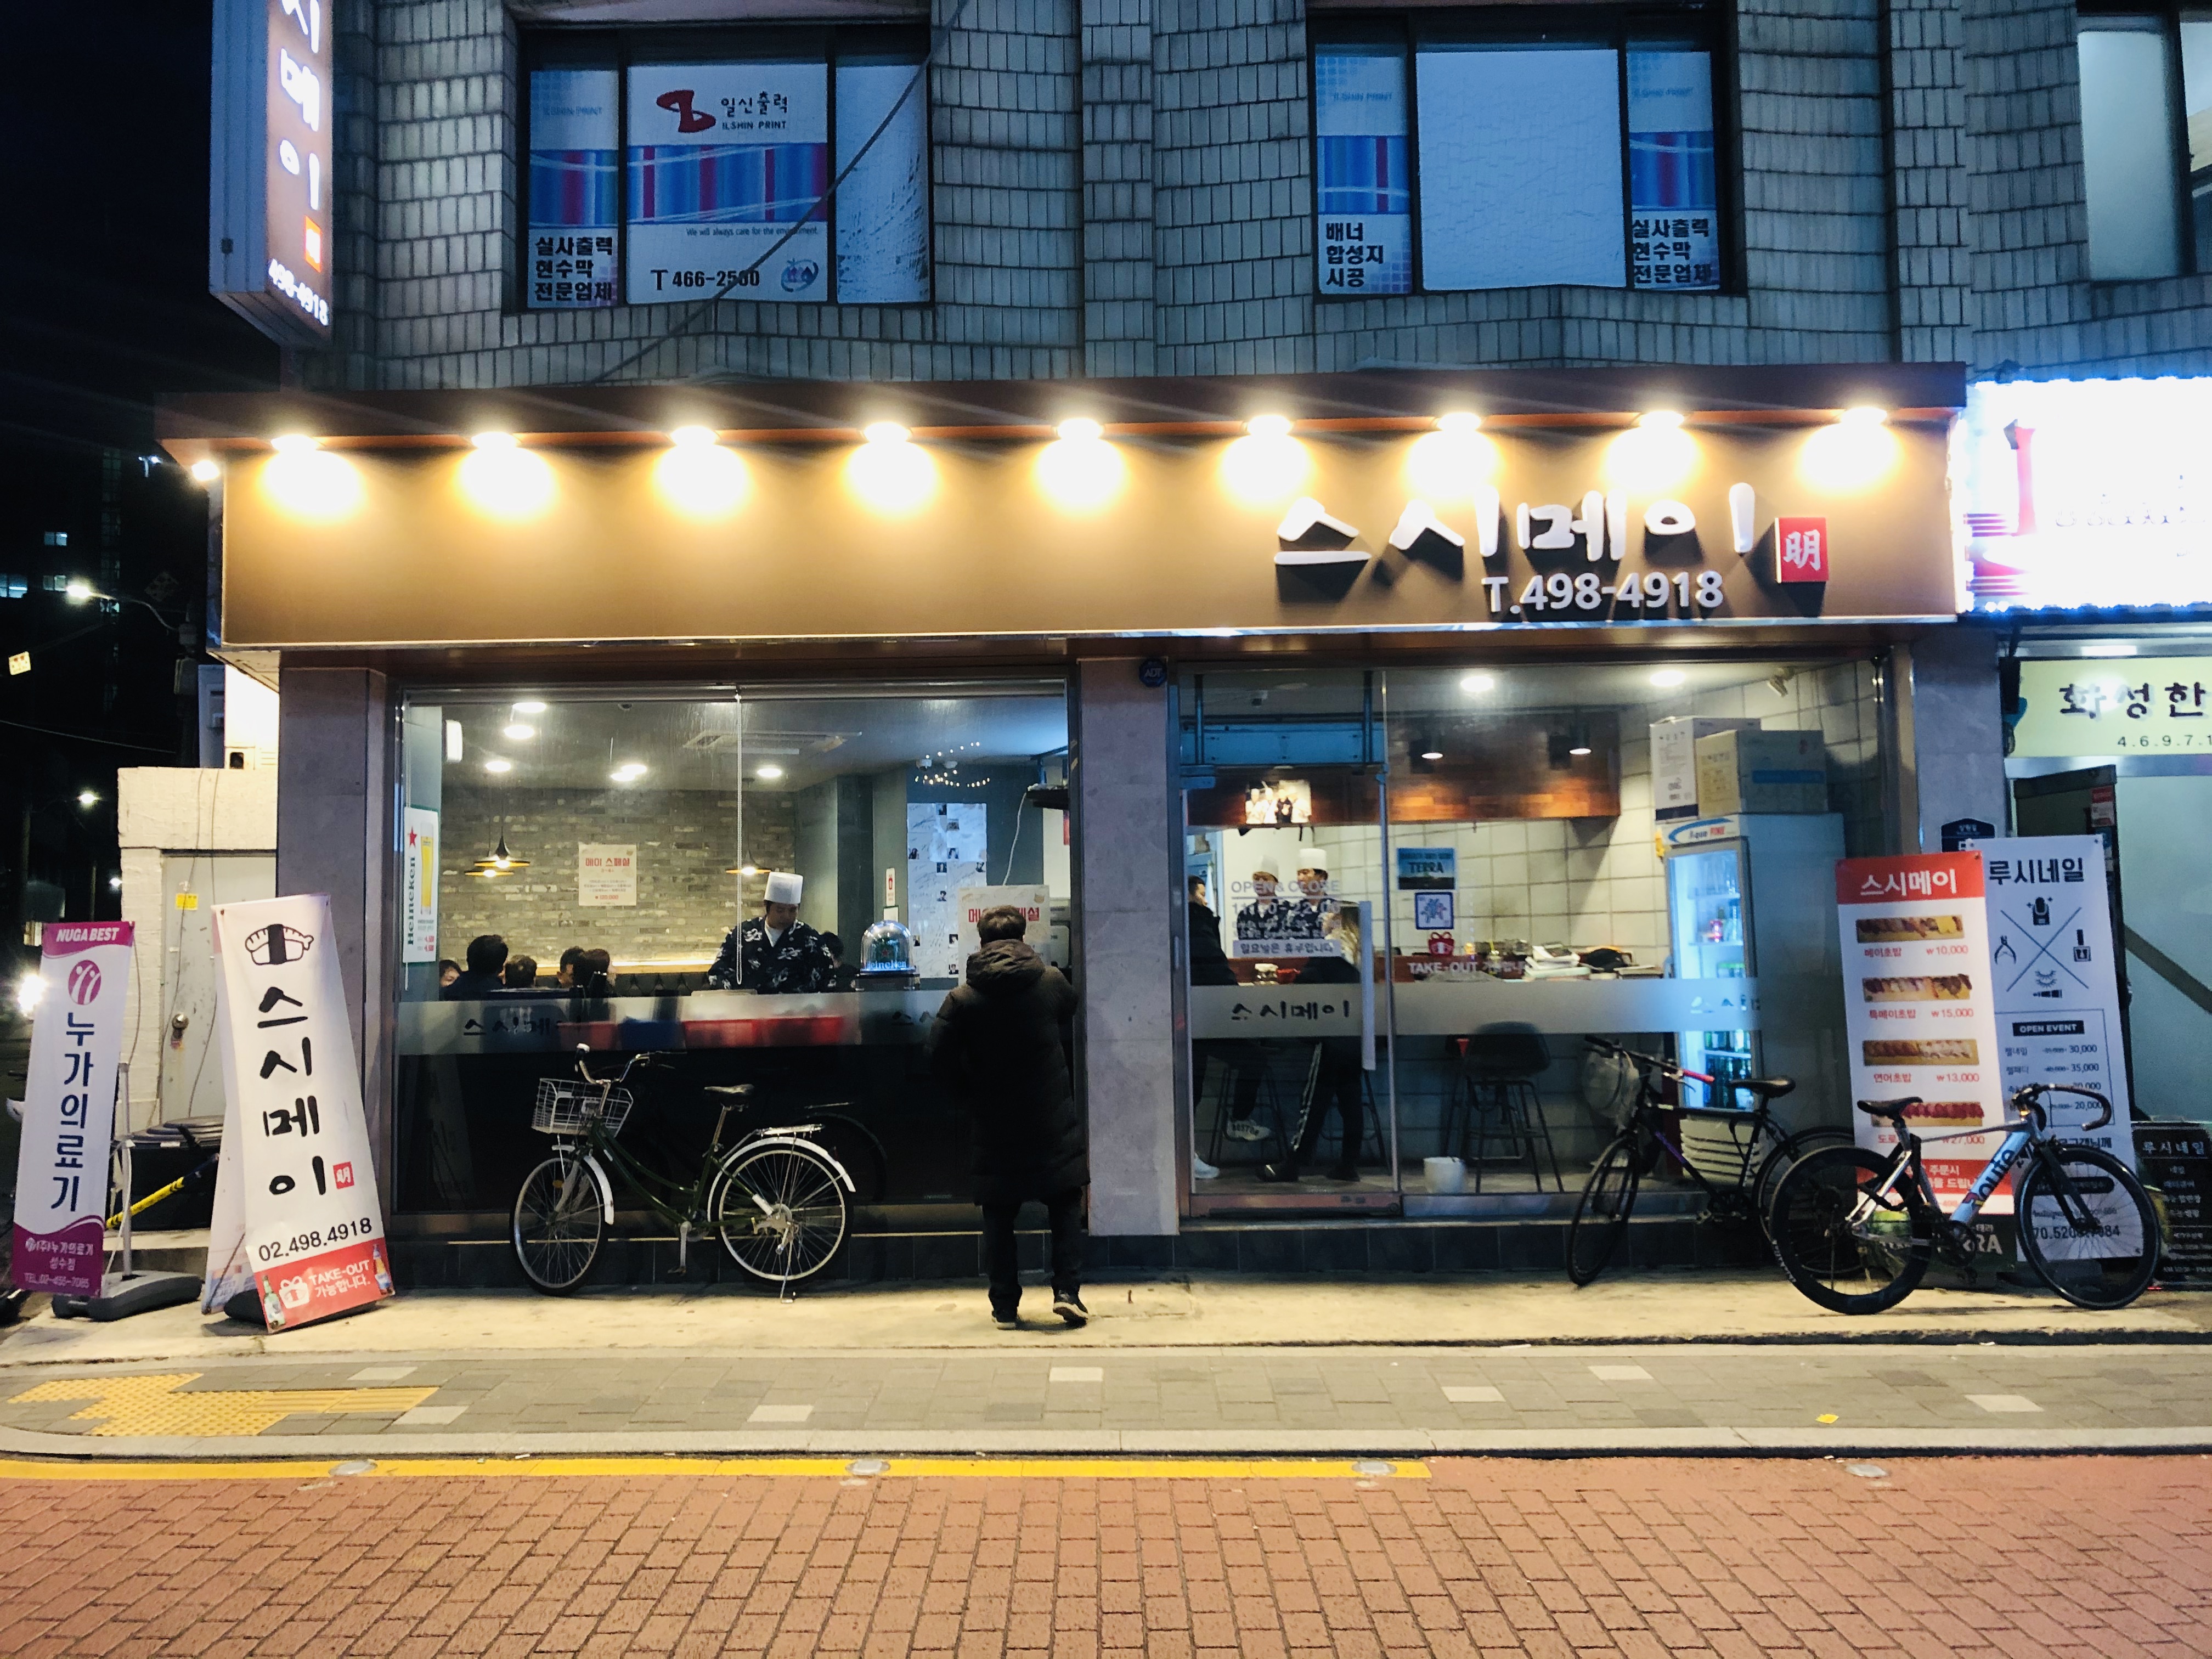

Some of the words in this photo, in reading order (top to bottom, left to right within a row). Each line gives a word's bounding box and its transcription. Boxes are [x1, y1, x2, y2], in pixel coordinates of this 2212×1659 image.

[720, 91, 788, 117] 일신출력
[722, 121, 754, 130] ILSHIN
[758, 120, 787, 129] PRINT
[1325, 222, 1364, 241] 배너
[1632, 218, 1709, 238] 실사출력
[535, 236, 613, 255] 실사출력
[1326, 245, 1384, 264] 합성지
[1633, 241, 1691, 261] 현수막
[535, 260, 594, 279] 현수막
[1326, 268, 1365, 287] 시공
[1633, 264, 1712, 284] 전문업체
[651, 269, 668, 291] T
[673, 269, 760, 288] 466-2500
[269, 259, 329, 326] 498-4918
[534, 282, 613, 302] 전문업체
[1274, 482, 1756, 565] 스시메이
[1782, 527, 1821, 571] 明
[1482, 571, 1723, 614] T.498-4918
[1989, 856, 2085, 885] 루시네일
[1231, 881, 1277, 893] OPEN
[1288, 879, 1340, 893] CLOSE
[1860, 867, 1957, 896] 스시메이
[56, 928, 88, 943] NUGA
[88, 927, 120, 941] BEST
[1231, 1000, 1350, 1021] 스시메이
[2019, 1025, 2044, 1034] OPEN
[2046, 1024, 2078, 1032] EVENT
[2069, 1044, 2098, 1054] 30,000
[2071, 1063, 2100, 1073] 35,000
[1874, 1073, 1912, 1084] 연어초밥
[257, 986, 326, 1196] 스시메이
[51, 1012, 95, 1212] 누가의료기
[1929, 1164, 1960, 1176] 주문시
[258, 1217, 373, 1262] 02.498.4918
[308, 1259, 370, 1286] TAKE-OUT
